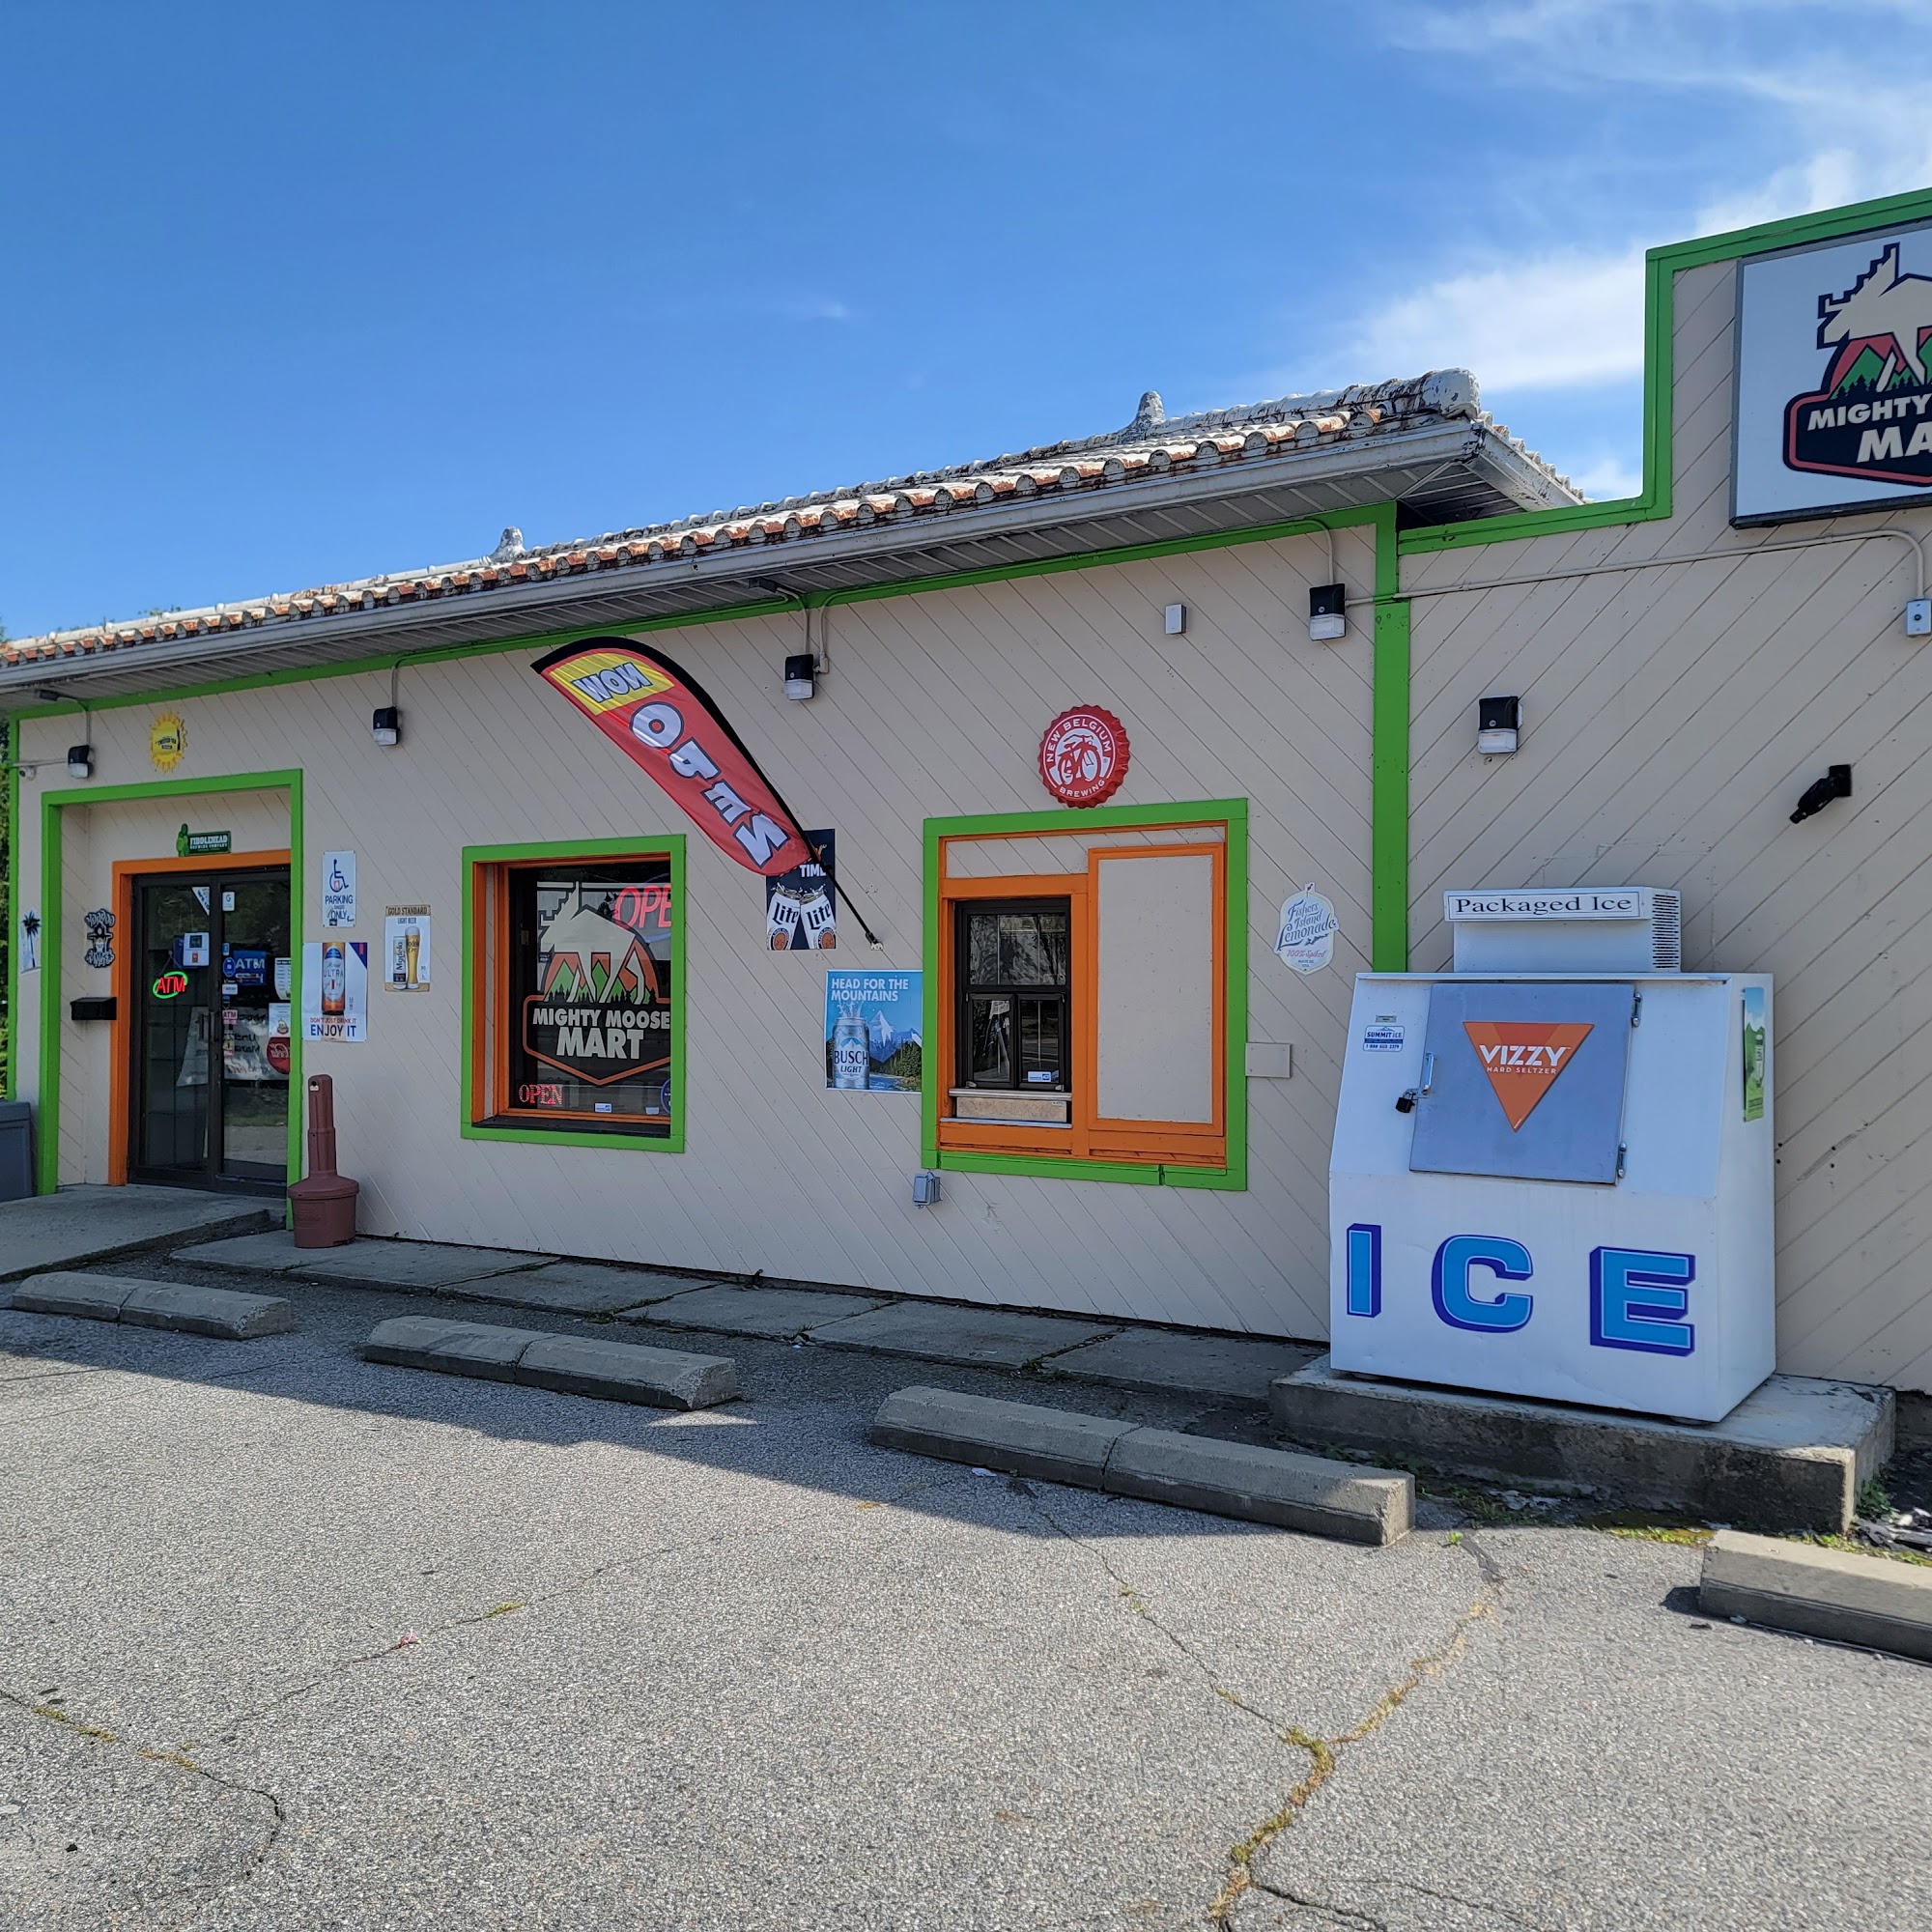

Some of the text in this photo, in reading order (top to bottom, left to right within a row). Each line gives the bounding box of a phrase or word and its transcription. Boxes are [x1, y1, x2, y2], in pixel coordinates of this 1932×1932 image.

[1807, 393, 1932, 431] MIGHTY
[1046, 718, 1112, 762] NEW BELGIUM
[1059, 779, 1105, 798] BREWING
[325, 895, 354, 905] PARKING
[1456, 896, 1633, 915] Packaged Ice
[330, 909, 347, 920] ONLY
[388, 906, 428, 916] GOLD STANDARD
[772, 901, 799, 925] Lite
[806, 901, 831, 930] Lite
[1288, 899, 1319, 923] Fishers
[1294, 908, 1323, 929] Island
[1276, 913, 1336, 952] Lemonade
[235, 957, 266, 970] ATM
[396, 941, 406, 971] Modelo
[323, 969, 343, 978] ULTRA
[831, 978, 909, 990] HEAD FOR THE
[156, 976, 185, 993] ATM
[831, 990, 898, 1002] MOUNTAINS
[532, 1008, 670, 1030] MIGHTY MOOSE
[310, 1024, 356, 1037] ENJOY IT
[556, 1026, 644, 1060] MART
[834, 1050, 869, 1065] BUSCH
[1479, 1044, 1567, 1066] VIZZY
[519, 1084, 563, 1106] OPEN
[1347, 1223, 1695, 1357] ICE
